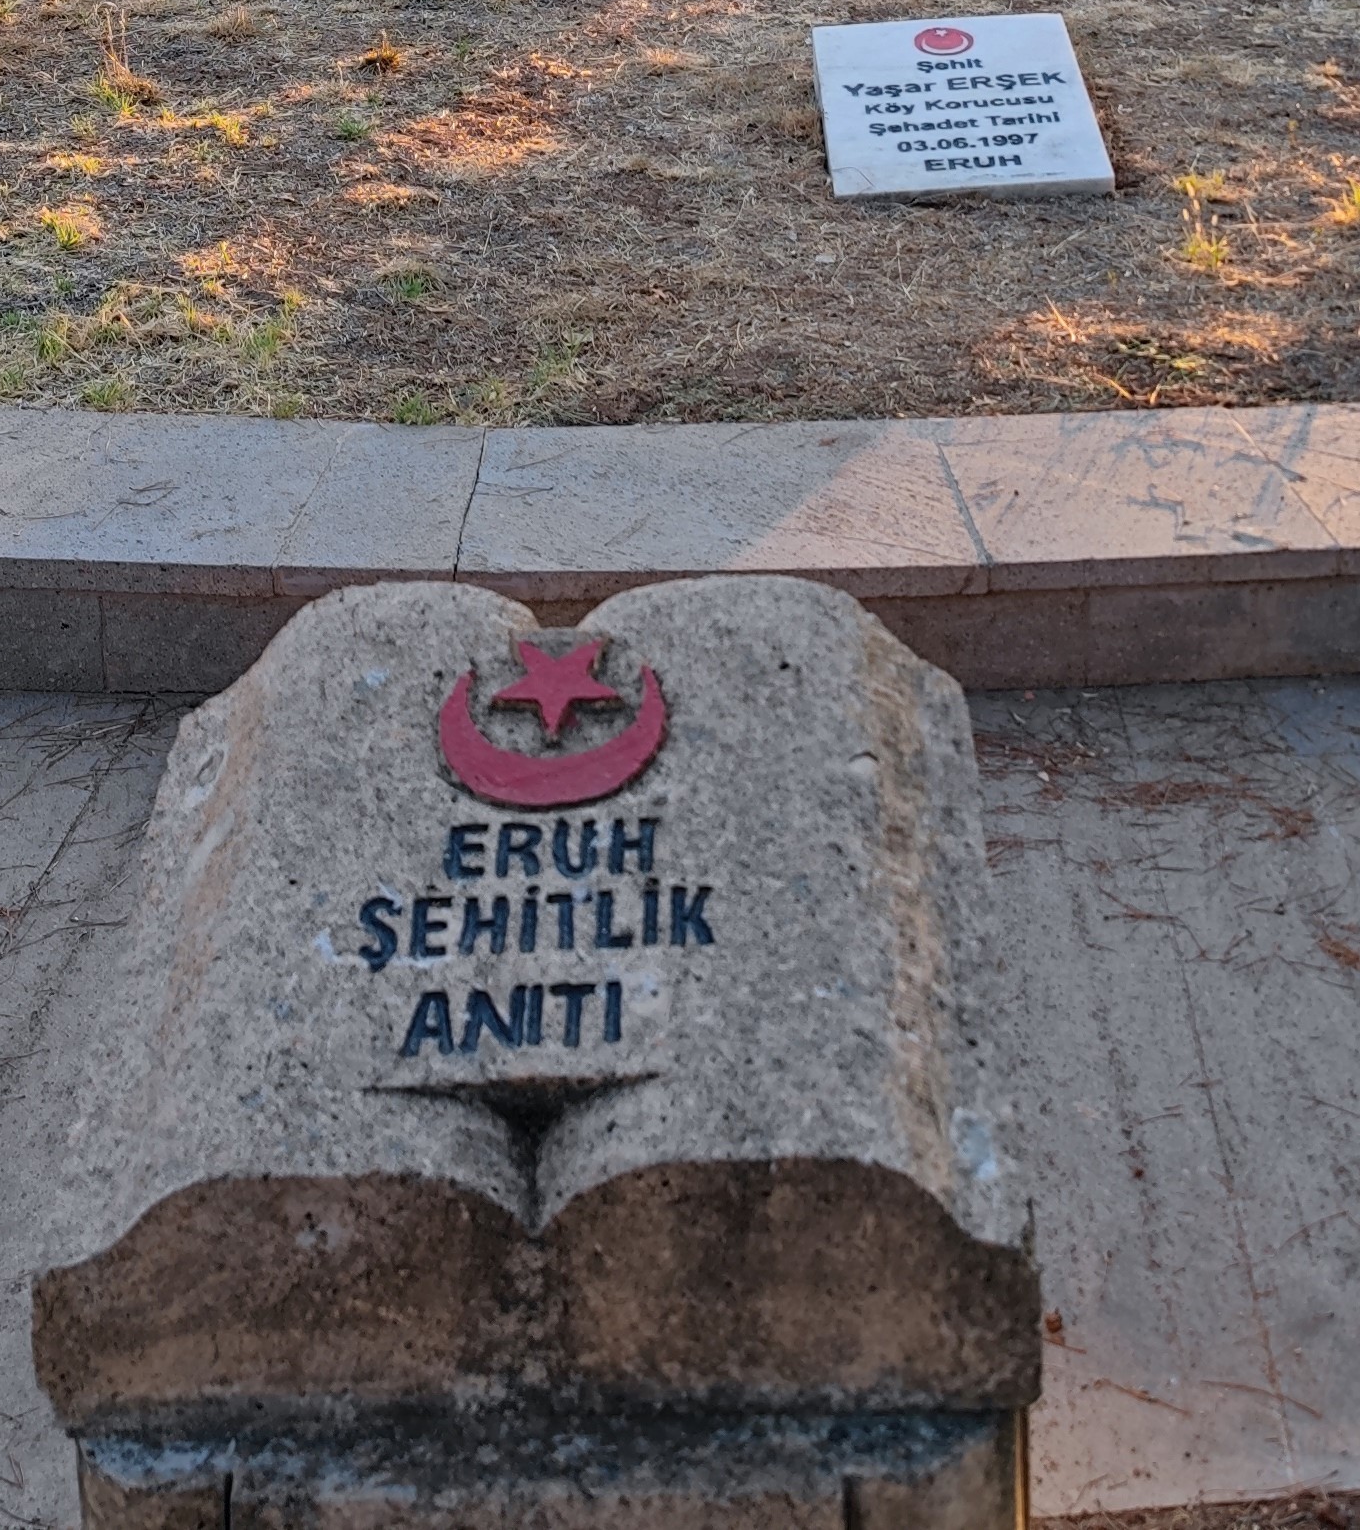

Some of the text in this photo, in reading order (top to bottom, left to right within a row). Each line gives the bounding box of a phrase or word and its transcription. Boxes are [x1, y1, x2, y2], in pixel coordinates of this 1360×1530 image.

[916, 58, 983, 73] Şehit
[842, 71, 1067, 98] Yaşar ERŞEK
[864, 94, 1054, 115] Köy Korucusu
[868, 111, 1061, 137] Şehadet Tarihi
[897, 132, 1039, 153] 03.06.1997
[923, 154, 1023, 171] ERUH
[444, 816, 661, 880] ERUH
[357, 877, 715, 972] ŞEHİTLİK
[397, 980, 623, 1058] ANITI
